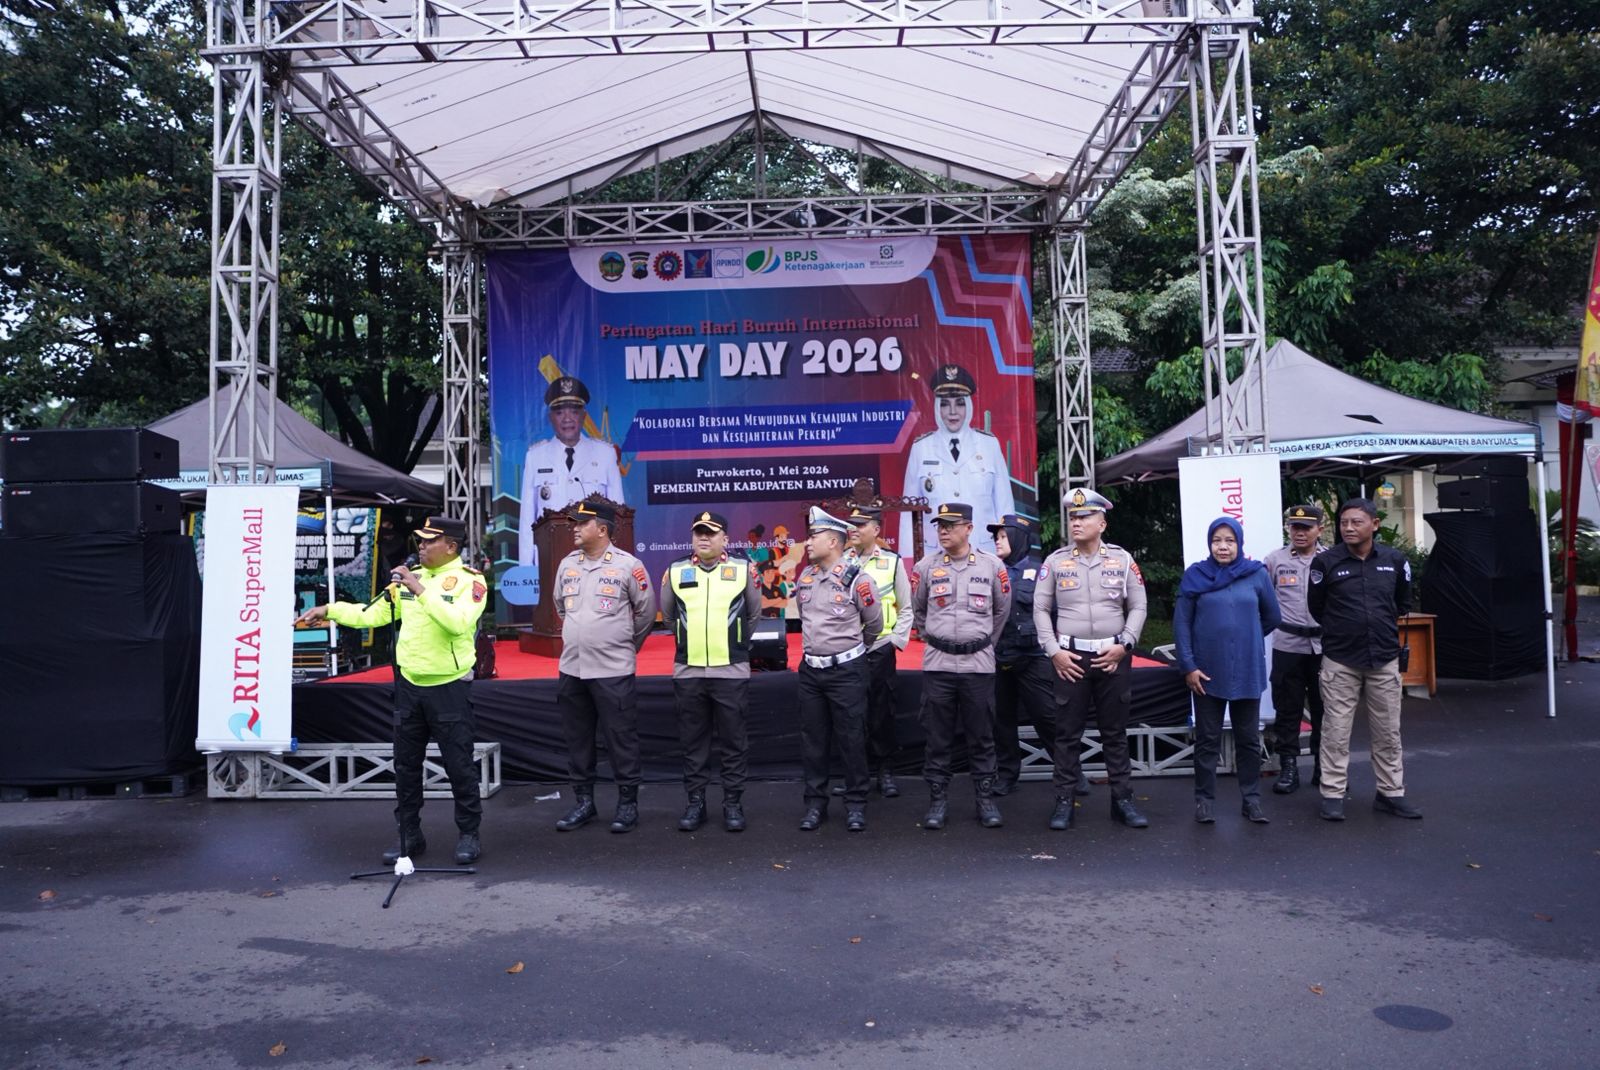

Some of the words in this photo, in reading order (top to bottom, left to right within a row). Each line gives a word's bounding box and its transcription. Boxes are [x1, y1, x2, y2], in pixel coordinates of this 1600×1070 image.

[785, 250, 818, 262] BPJS
[716, 258, 741, 267] APINDO
[785, 261, 865, 271] Ketenagakerjaan
[600, 324, 694, 339] Peringatan
[700, 321, 736, 334] Hari
[743, 316, 796, 333] Buruh
[803, 313, 919, 331] Internasional
[625, 343, 705, 380] MAY
[719, 341, 788, 377] DAY
[802, 336, 903, 374] 2026
[699, 415, 741, 428] BERSAMA
[744, 413, 807, 427] MEWUJUDKAN
[810, 411, 858, 425] KEMAJUAN
[862, 410, 905, 422] INDUSTRI
[723, 430, 794, 443] KESEJAHTERAAN
[1335, 438, 1377, 449] KOPERASI
[1379, 438, 1398, 447] DAN
[1399, 438, 1418, 446] UKM
[1419, 438, 1469, 446] KABUPATEN
[1471, 438, 1519, 446] BANYUMAS
[257, 472, 304, 482] BYUMAS
[697, 467, 765, 478] Purwokerto,
[769, 467, 775, 476] 1
[779, 465, 799, 476] Mei
[802, 465, 829, 475] 2026
[187, 475, 206, 483] UKM
[653, 481, 730, 494] PEMERINTAH
[733, 479, 803, 492] KABUPATEN
[239, 508, 265, 623] SuperMall
[970, 576, 990, 584] POLRI
[1056, 571, 1079, 579] FAIZAL
[503, 579, 520, 587] Drs.
[598, 578, 621, 586] POLRI
[233, 627, 261, 703] RITA
